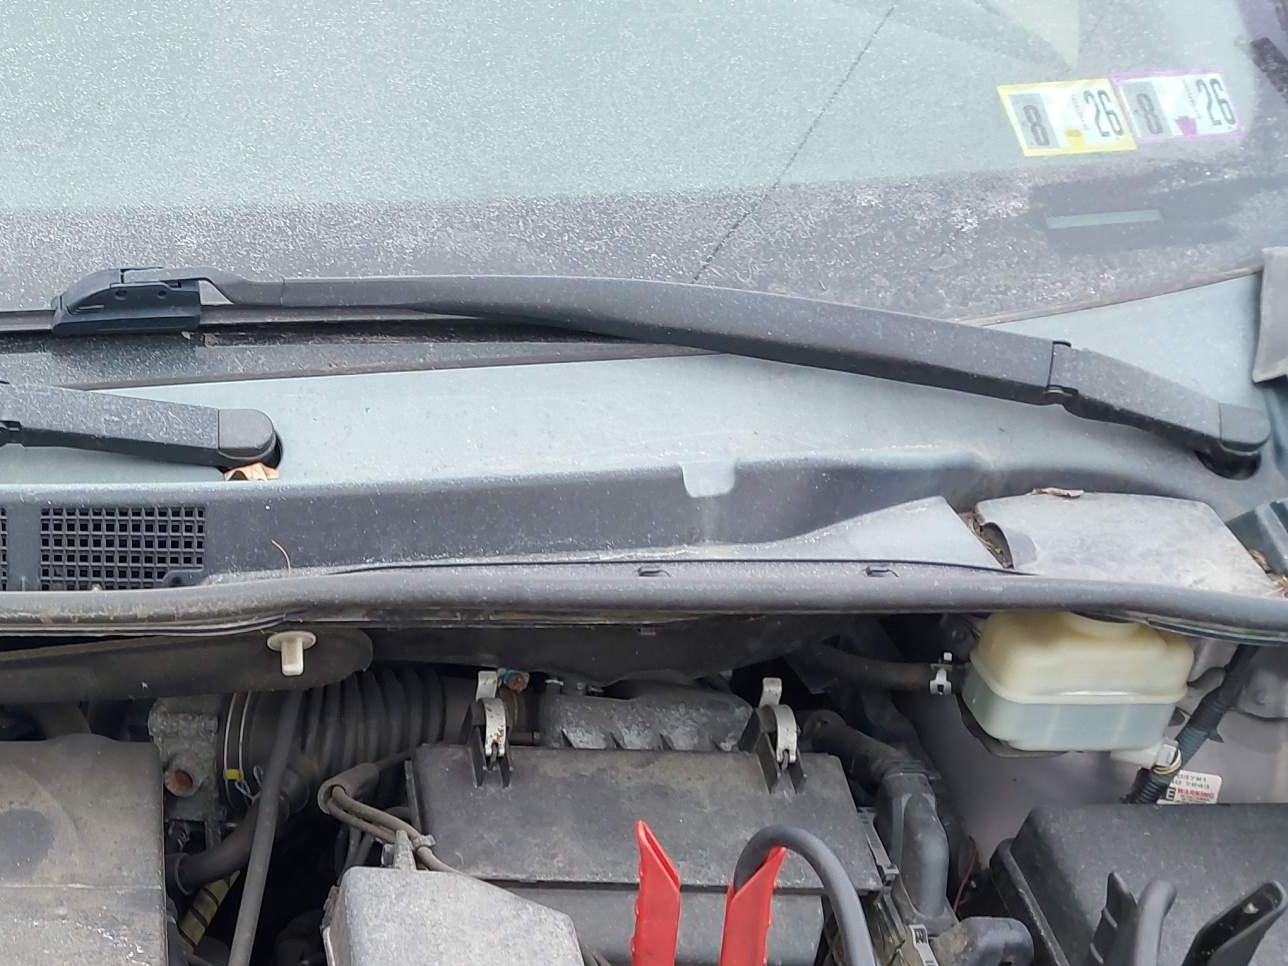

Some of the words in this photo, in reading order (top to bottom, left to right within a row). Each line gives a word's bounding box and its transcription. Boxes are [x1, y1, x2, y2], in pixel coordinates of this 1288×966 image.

[1023, 104, 1050, 147] 8
[1085, 89, 1125, 138] 26
[1136, 93, 1163, 136] 8
[1196, 77, 1237, 127] 26
